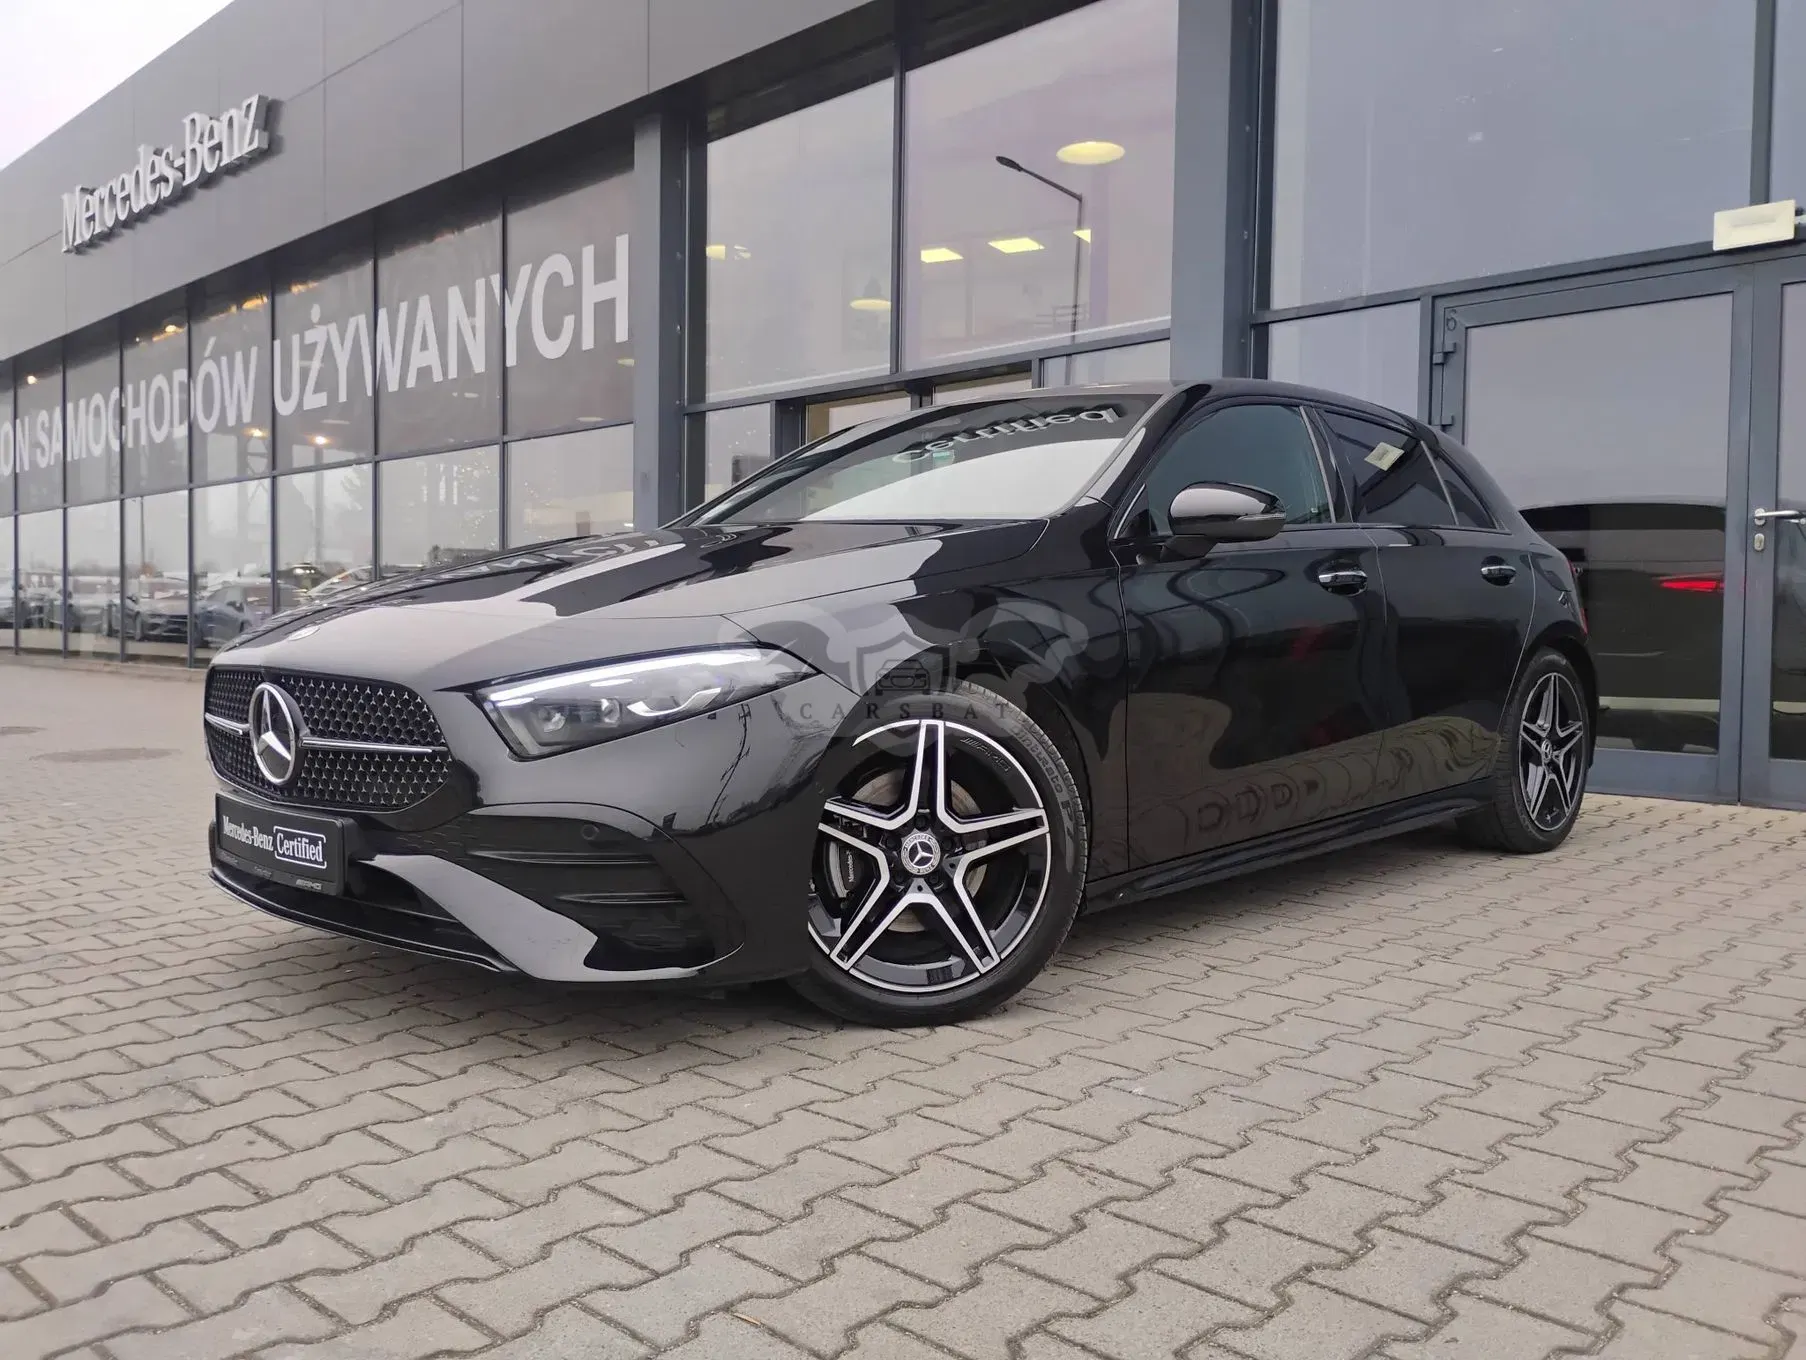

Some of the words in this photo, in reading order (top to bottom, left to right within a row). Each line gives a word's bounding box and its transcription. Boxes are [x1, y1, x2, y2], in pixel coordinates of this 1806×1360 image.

[61, 94, 269, 253] Mercedes-Benz
[36, 336, 258, 469] SAMOCHODÓW
[272, 234, 629, 416] UŻYWANYCH
[222, 815, 274, 851] Mercedes-Benz
[276, 832, 323, 862] Certified
